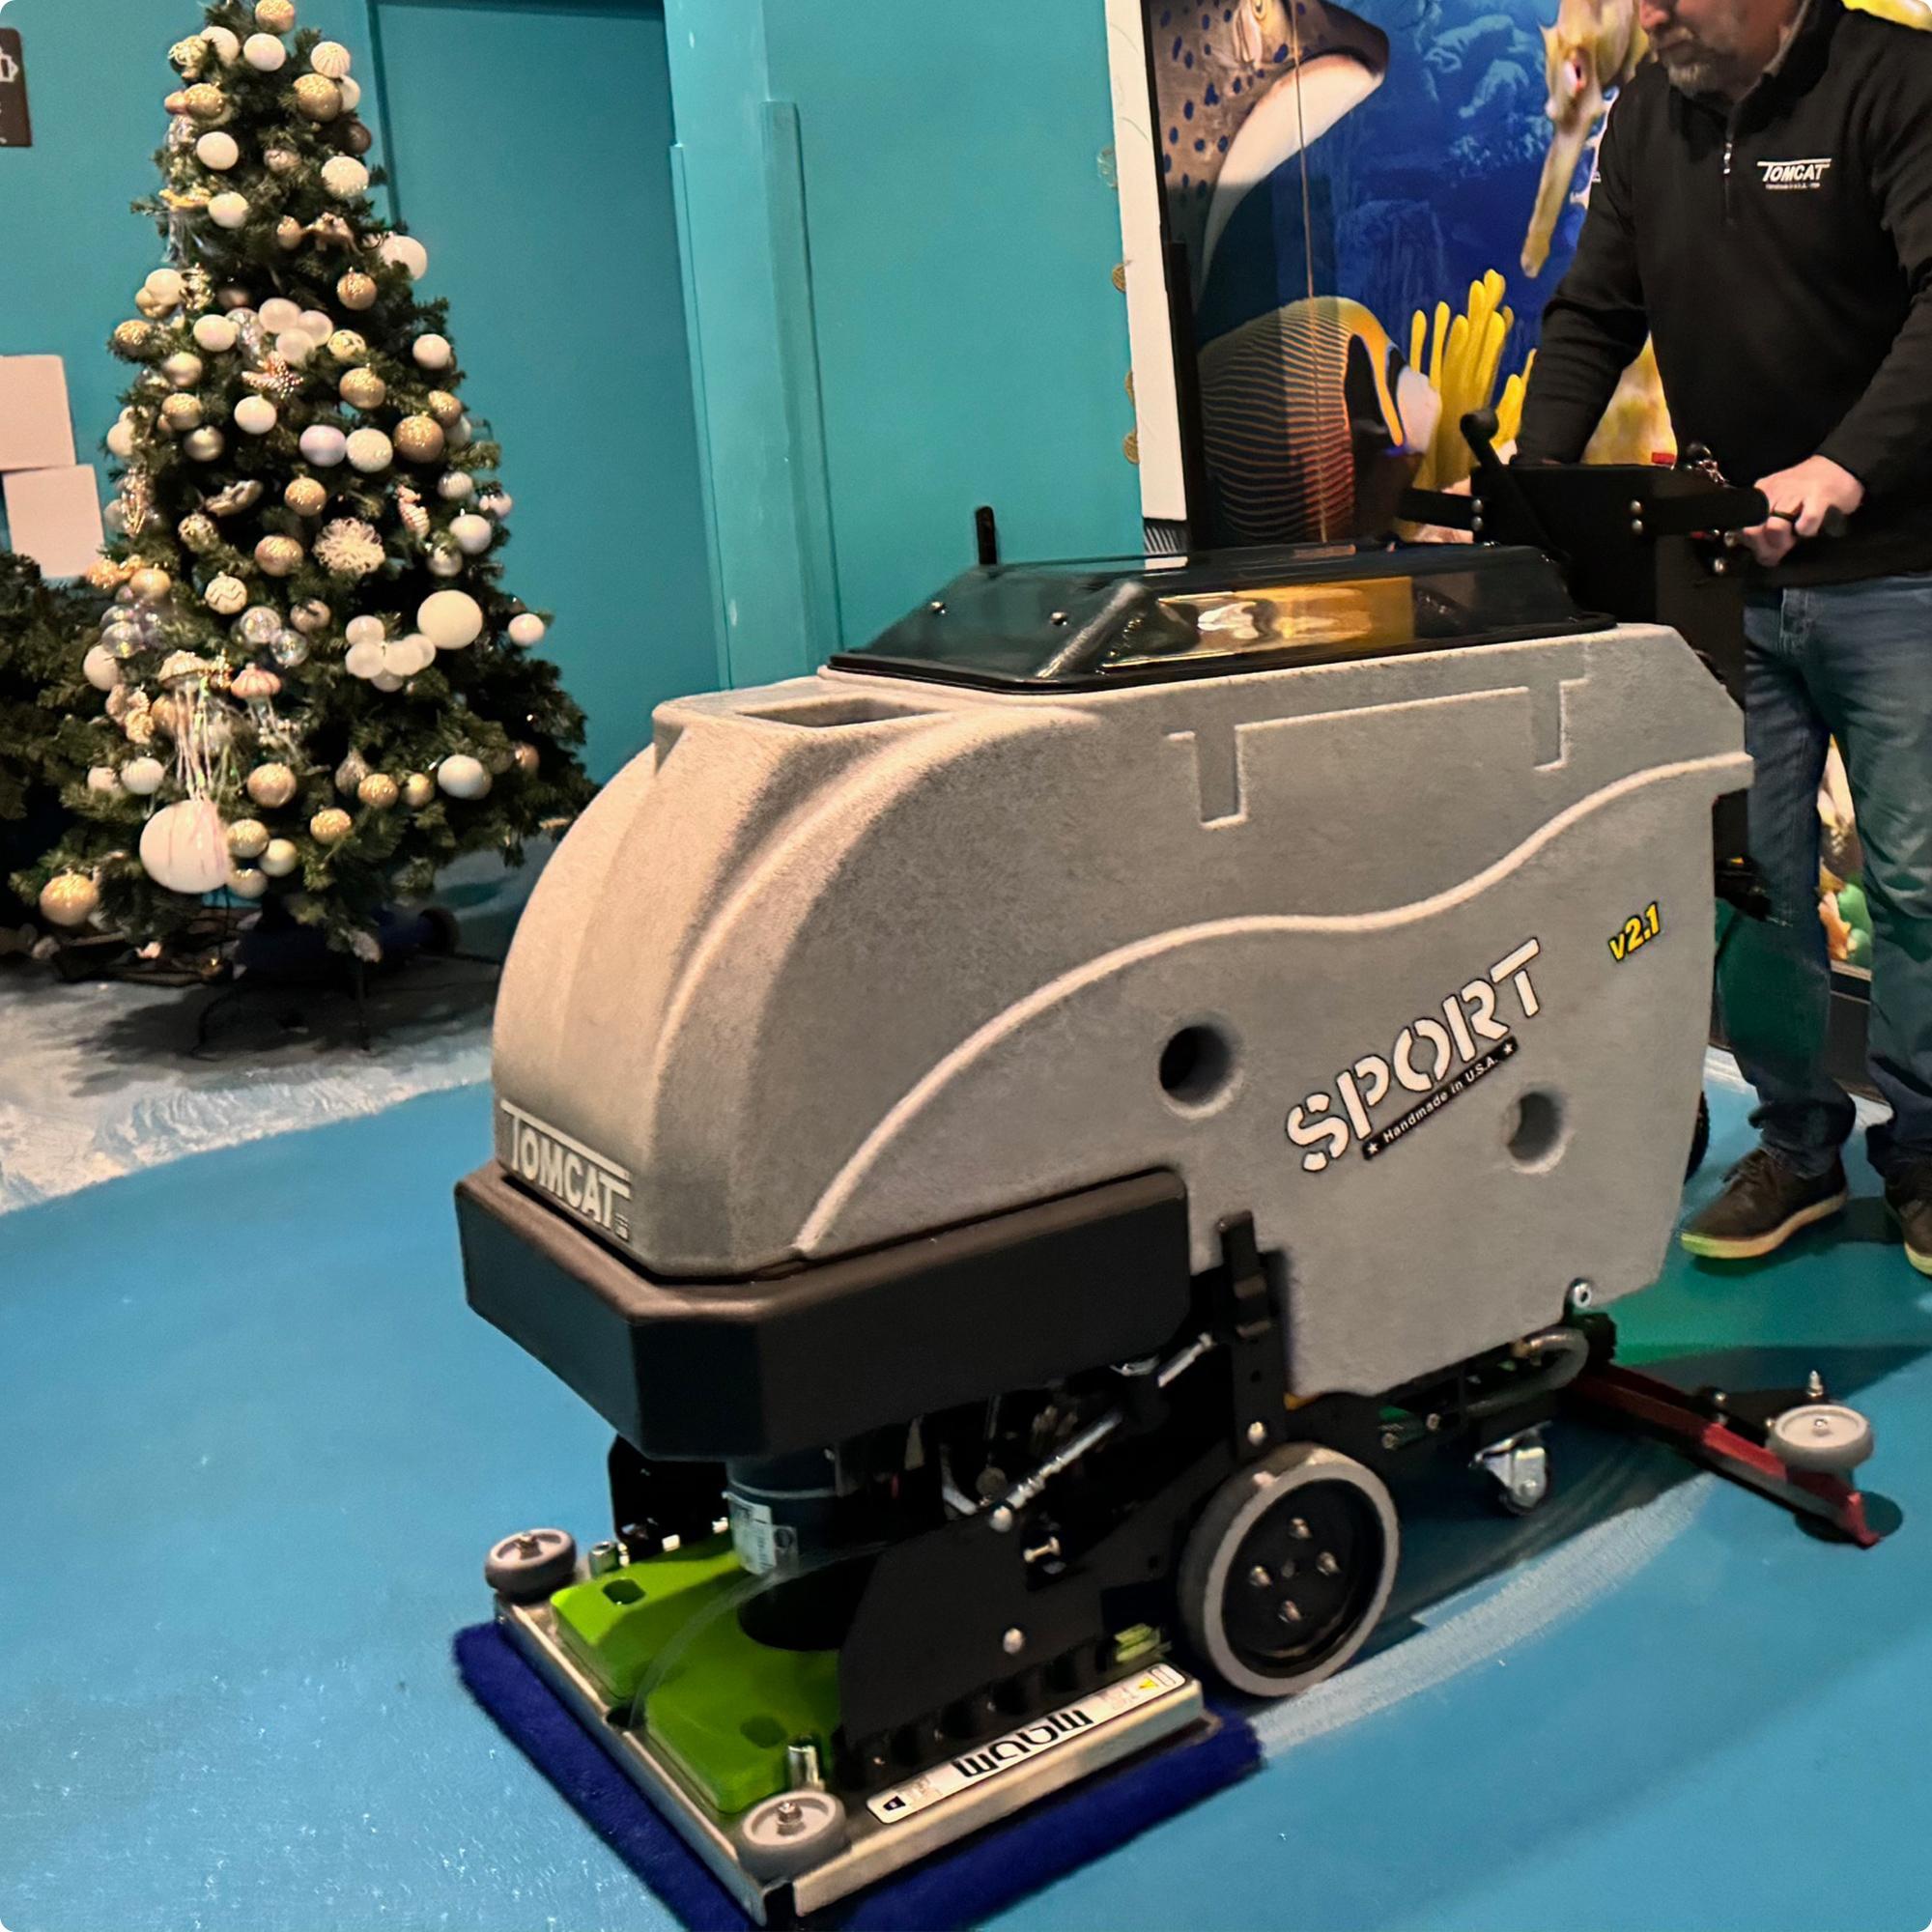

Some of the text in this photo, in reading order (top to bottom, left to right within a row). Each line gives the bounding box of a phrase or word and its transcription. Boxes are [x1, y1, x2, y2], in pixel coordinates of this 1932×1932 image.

[1756, 157, 1832, 183] TOMCAT
[1608, 901, 1661, 962] v2.1
[1286, 936, 1542, 1173] SPORT
[1382, 1056, 1499, 1143] Handmade in U.S.A.
[500, 1098, 631, 1229] TOMCAT
